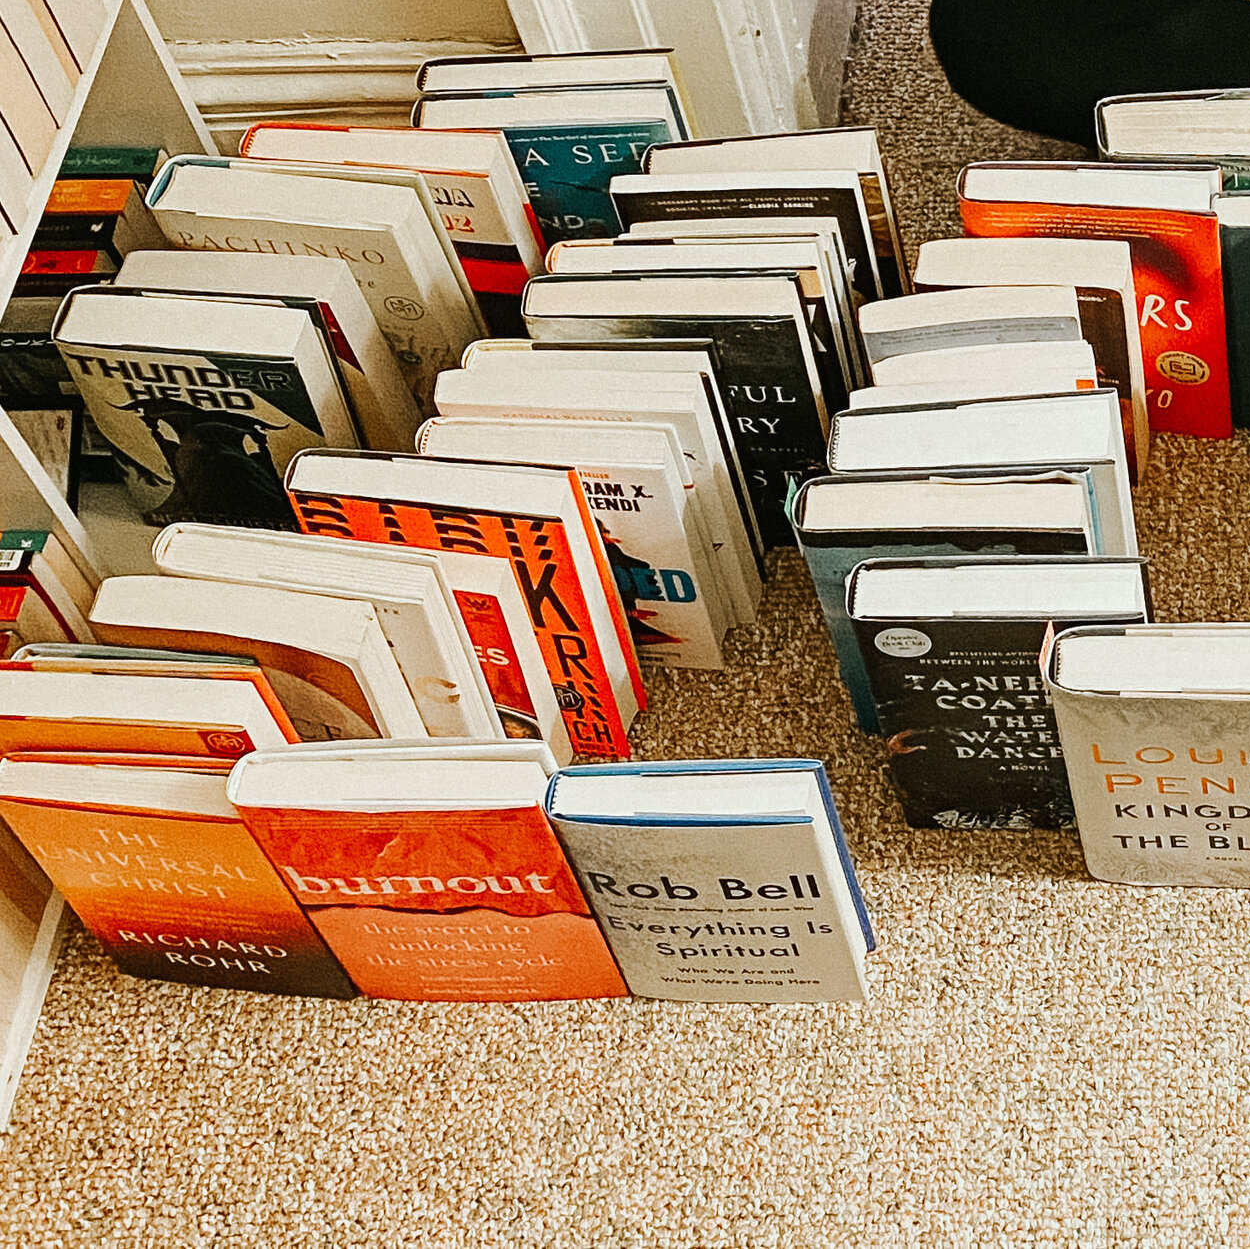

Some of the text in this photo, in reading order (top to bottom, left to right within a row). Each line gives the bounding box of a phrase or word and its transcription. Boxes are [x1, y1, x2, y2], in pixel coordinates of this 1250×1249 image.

[177, 231, 385, 265] PACHINKO
[64, 352, 293, 391] THUNDER
[124, 382, 255, 410] HEAD
[919, 658, 1039, 666] BETWEEN THE WORL
[904, 674, 1050, 692] TA-NEH
[935, 694, 1053, 710] COAT
[982, 715, 1048, 728] THE
[960, 731, 1054, 744] WATE
[955, 746, 1064, 759] DANCE
[1205, 822, 1232, 832] OF
[98, 829, 161, 848] THE
[1112, 834, 1190, 849] THE
[37, 844, 258, 882] UNIVERSAL
[90, 872, 228, 899] CHRIST
[280, 865, 555, 897] burnout
[586, 871, 822, 901] Rob Bell
[362, 922, 531, 935] the secret to
[606, 915, 834, 939] Everything Is
[117, 929, 288, 959] RICHARD
[389, 939, 527, 954] unlocking
[655, 942, 801, 960] Spiritual
[165, 950, 272, 975] ROHR
[367, 953, 564, 970] the stress cycle
[676, 966, 709, 975] Who
[712, 967, 736, 975] We
[770, 967, 796, 975] and
[659, 975, 697, 984] What
[744, 978, 784, 986] Doing
